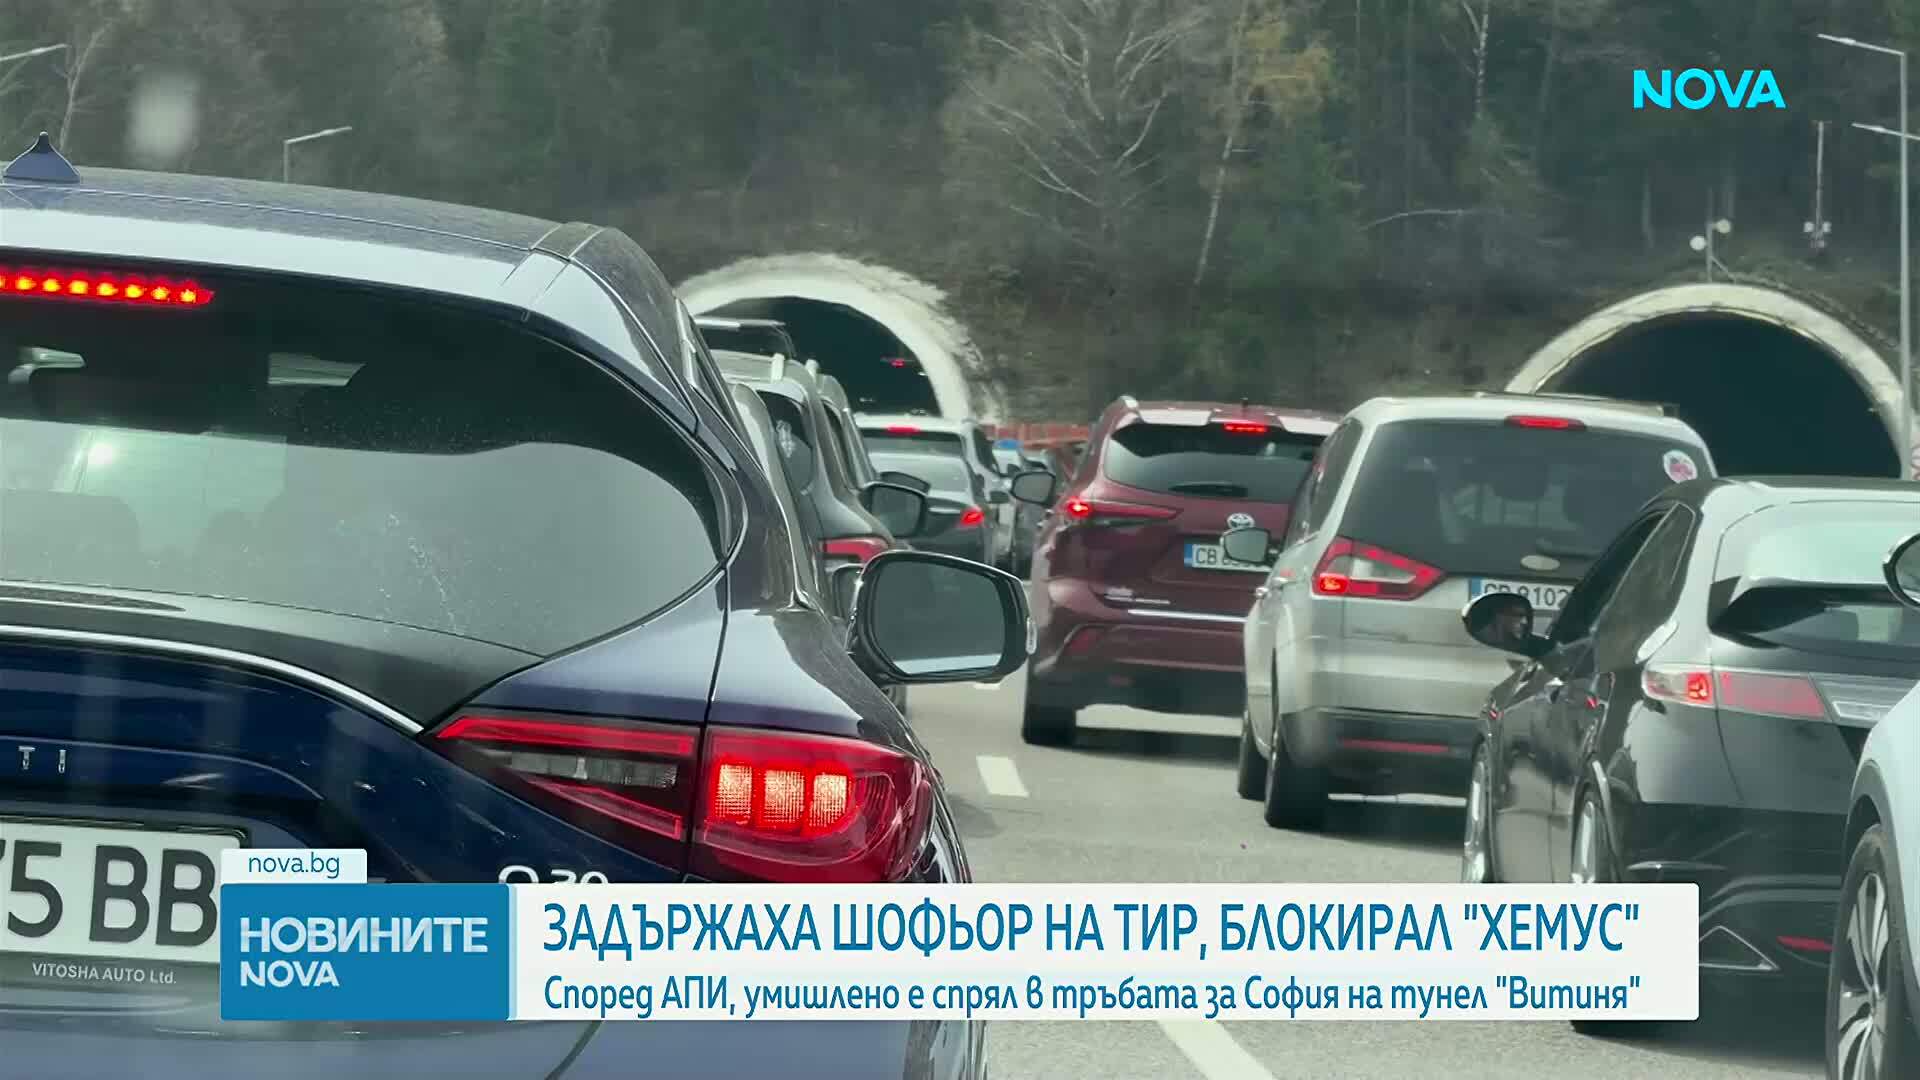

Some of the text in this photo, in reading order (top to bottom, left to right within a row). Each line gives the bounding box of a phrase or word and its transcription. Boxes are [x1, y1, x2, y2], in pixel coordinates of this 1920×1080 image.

[89, 844, 218, 947] BB
[32, 963, 178, 985] VITOSHA AUTO Ltd.
